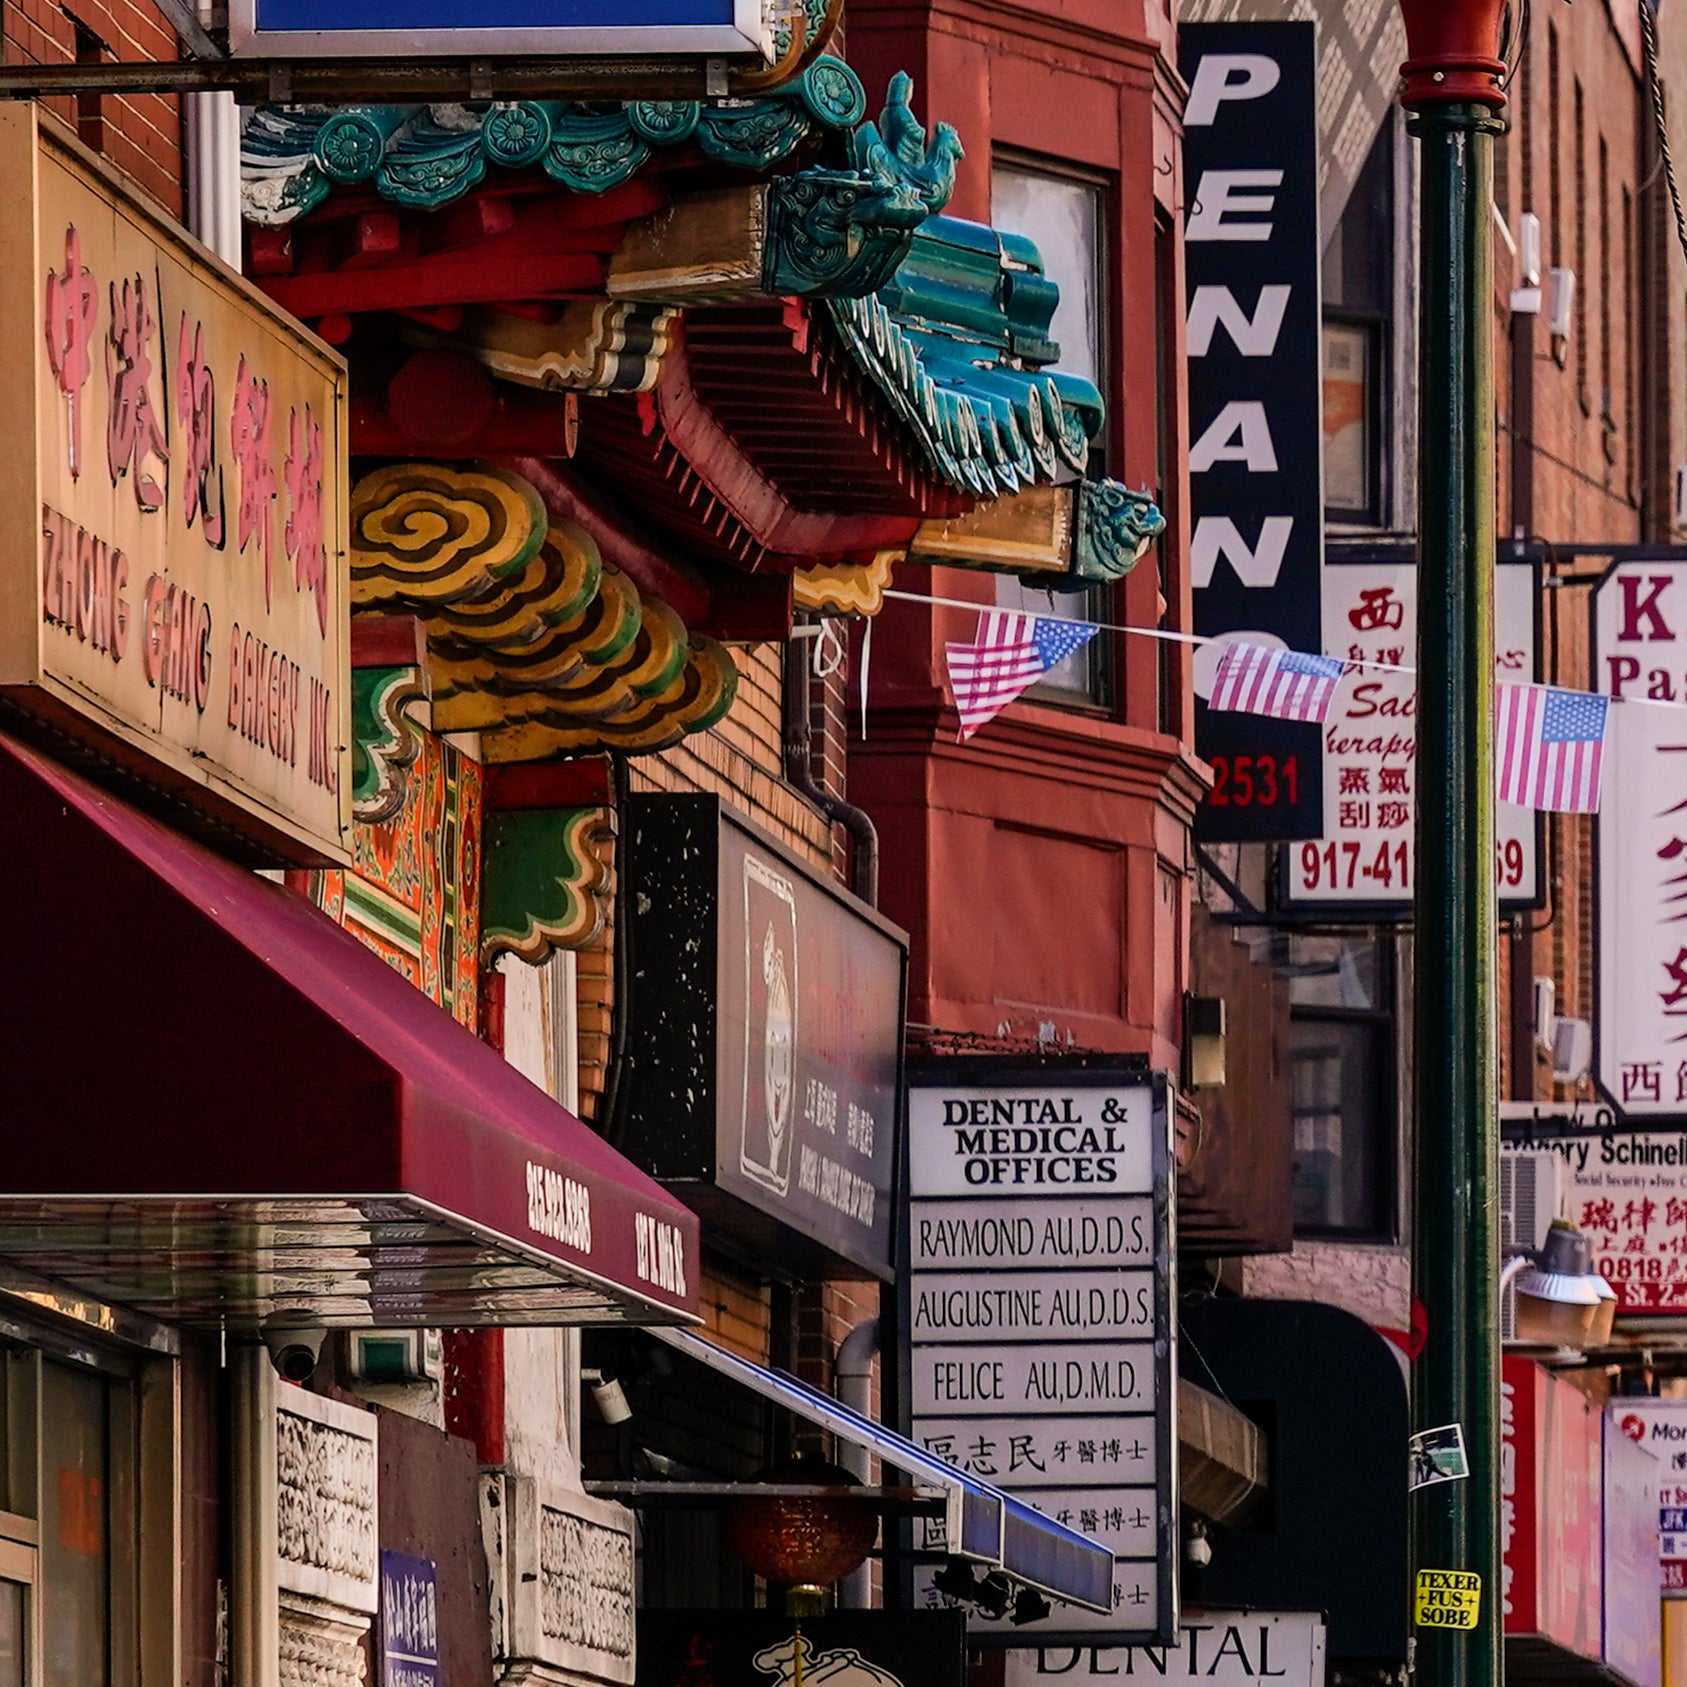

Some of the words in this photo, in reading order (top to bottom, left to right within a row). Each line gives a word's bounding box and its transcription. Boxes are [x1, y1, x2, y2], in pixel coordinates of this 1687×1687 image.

[43, 504, 130, 663] ZHONG
[143, 571, 212, 715] GANG
[227, 622, 301, 770] BAKERY
[1326, 724, 1416, 762] herapy
[1210, 756, 1298, 808] 2531
[942, 1099, 1082, 1126] DENTAL
[1100, 1098, 1128, 1123] &
[955, 1128, 1126, 1155] MEDICAL
[964, 1158, 1117, 1184] OFFICES
[920, 1219, 1034, 1258] RAYMOND
[916, 1290, 1043, 1329] AUGUSTINE
[934, 1363, 1004, 1401] FELICE
[1419, 1571, 1479, 1591] TEXER
[1420, 1607, 1471, 1628] SOBE
